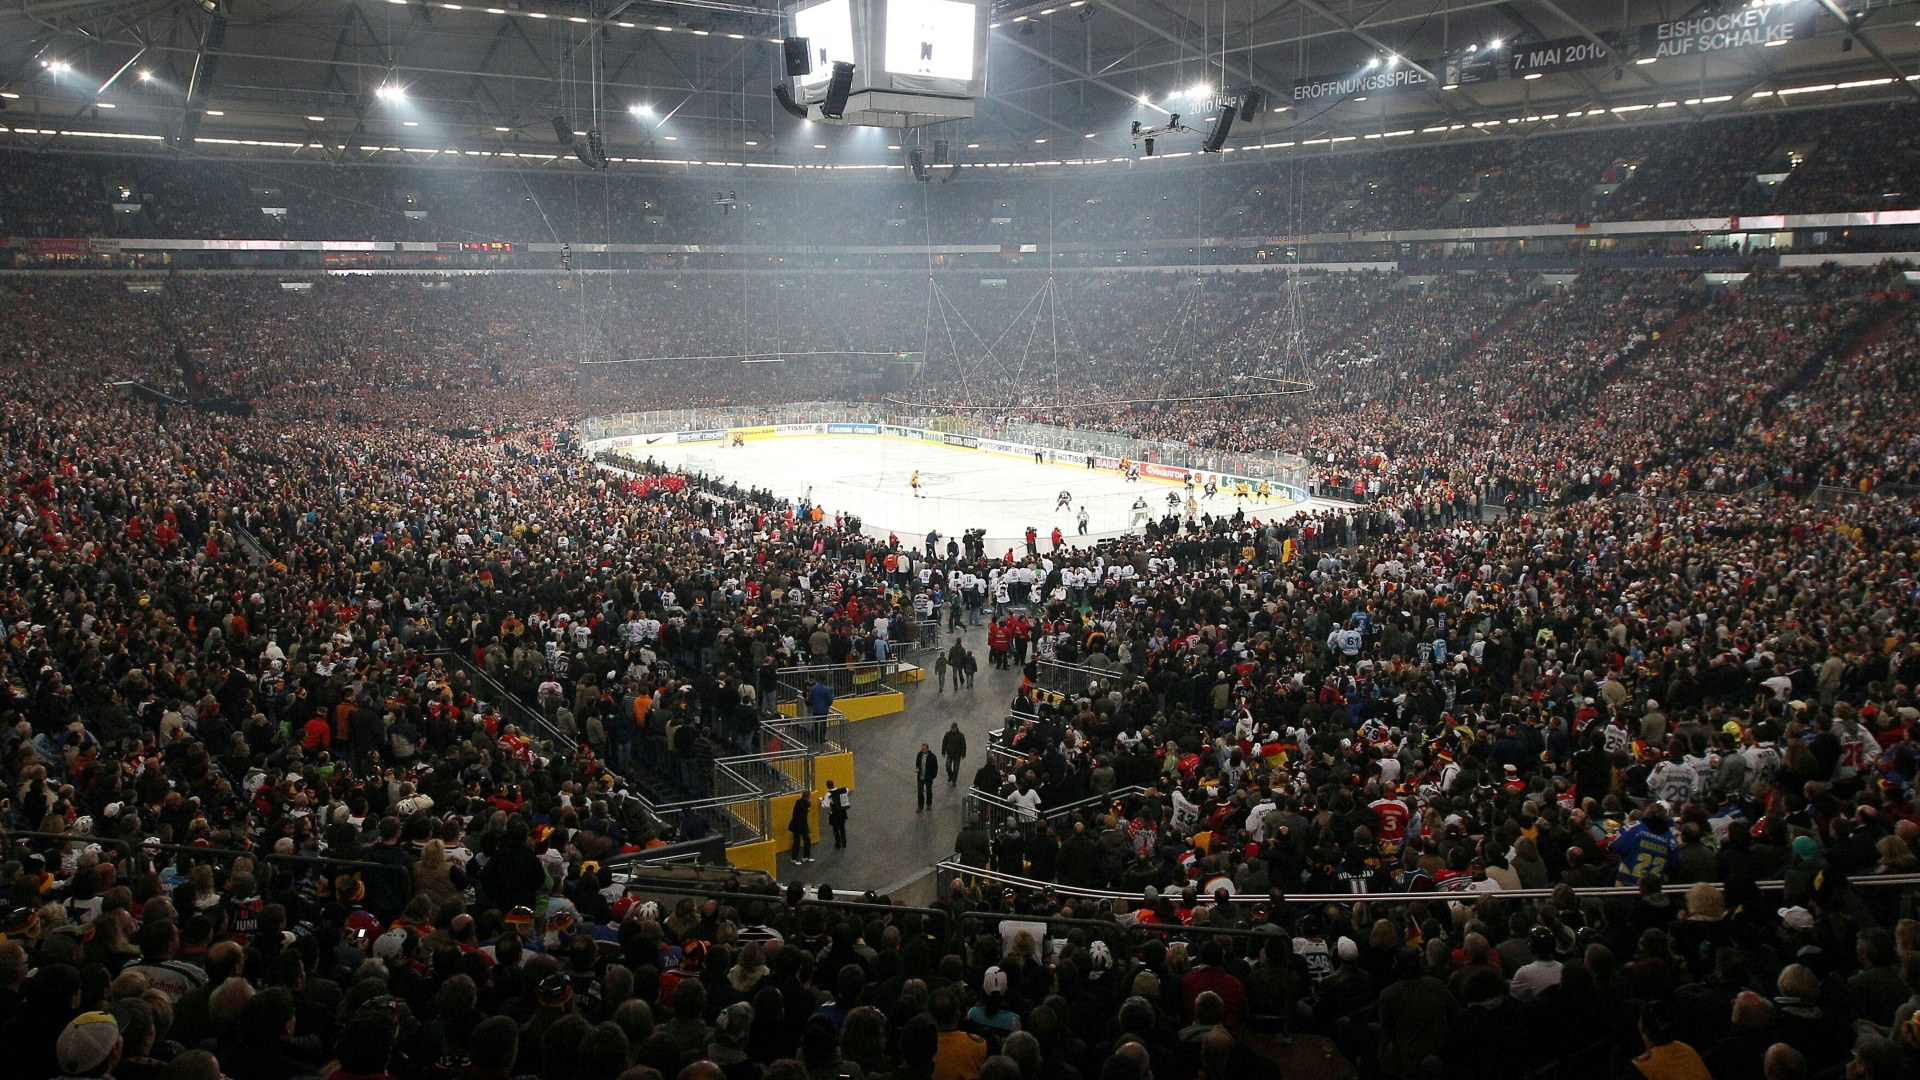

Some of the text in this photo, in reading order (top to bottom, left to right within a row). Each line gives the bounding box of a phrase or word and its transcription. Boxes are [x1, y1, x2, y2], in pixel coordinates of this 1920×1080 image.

[1657, 7, 1772, 40] EISHOCKEY
[1655, 22, 1796, 58] AUF SCHALKE
[1513, 53, 1525, 70] 7.
[1529, 47, 1561, 68] MAI
[1565, 42, 1607, 63] 2010
[1294, 68, 1427, 100] ERÖFFNUNGSSPIEL
[1188, 99, 1214, 116] 2010
[787, 424, 813, 432] TISSOT
[982, 442, 1012, 451] INTERSPORT
[1347, 636, 1359, 646] 61
[1365, 726, 1380, 741] 79
[1384, 815, 1398, 832] 3
[1631, 853, 1667, 878] 22
[148, 978, 188, 996] Schmidt
